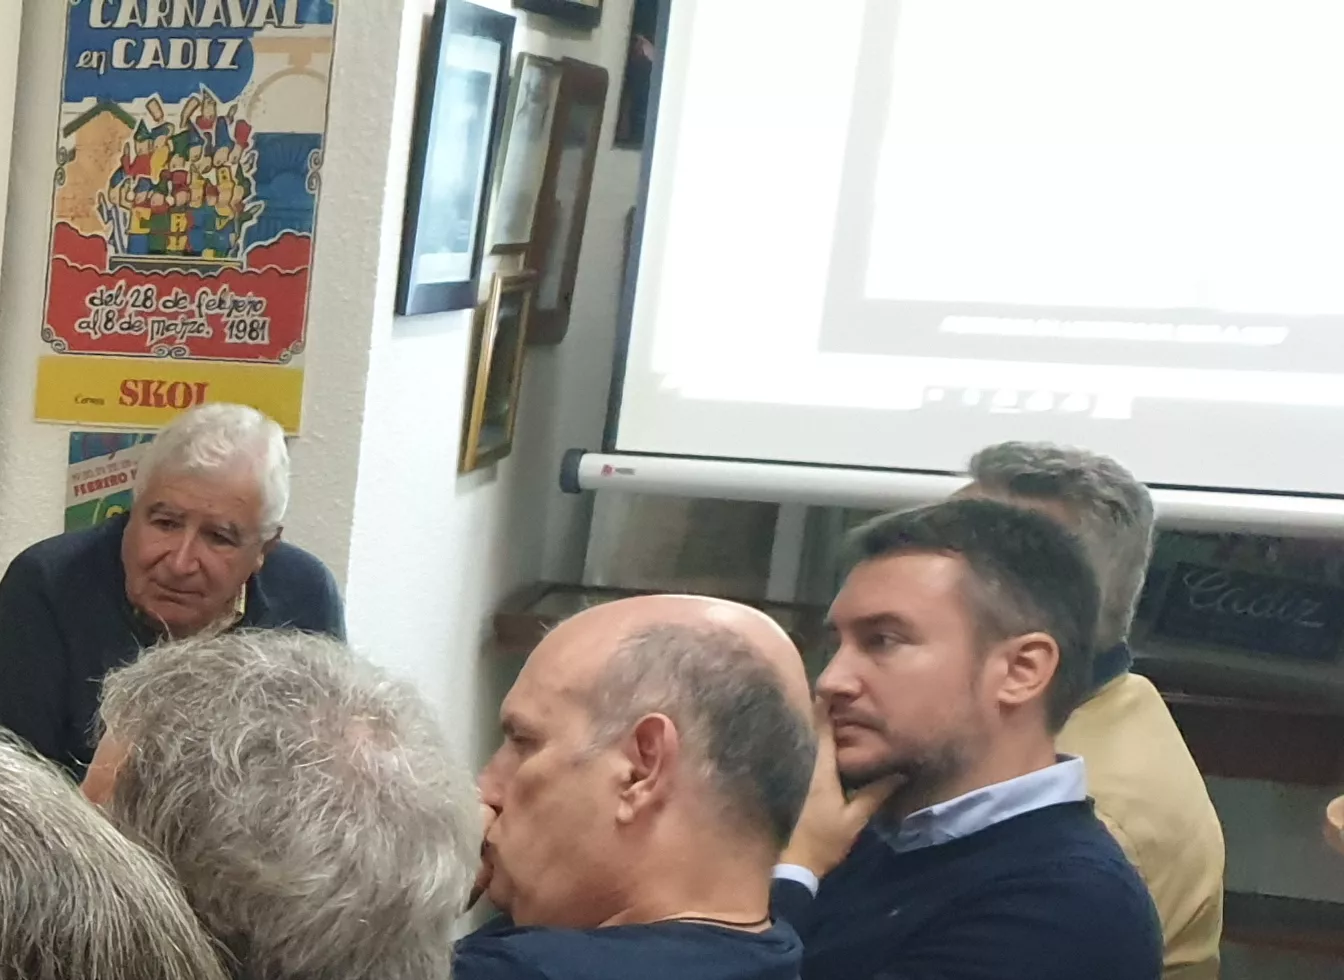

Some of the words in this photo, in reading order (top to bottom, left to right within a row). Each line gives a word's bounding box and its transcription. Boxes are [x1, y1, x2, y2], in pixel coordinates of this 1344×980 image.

[89, 0, 303, 28] CARNAVAL
[75, 50, 106, 75] en
[112, 38, 243, 69] CADIZ
[88, 281, 125, 308] del
[129, 286, 155, 310] 28
[162, 288, 188, 310] de
[196, 286, 263, 318] febrero
[78, 312, 99, 337] al
[102, 309, 115, 332] 8
[119, 315, 144, 332] de
[227, 318, 268, 342] 1981
